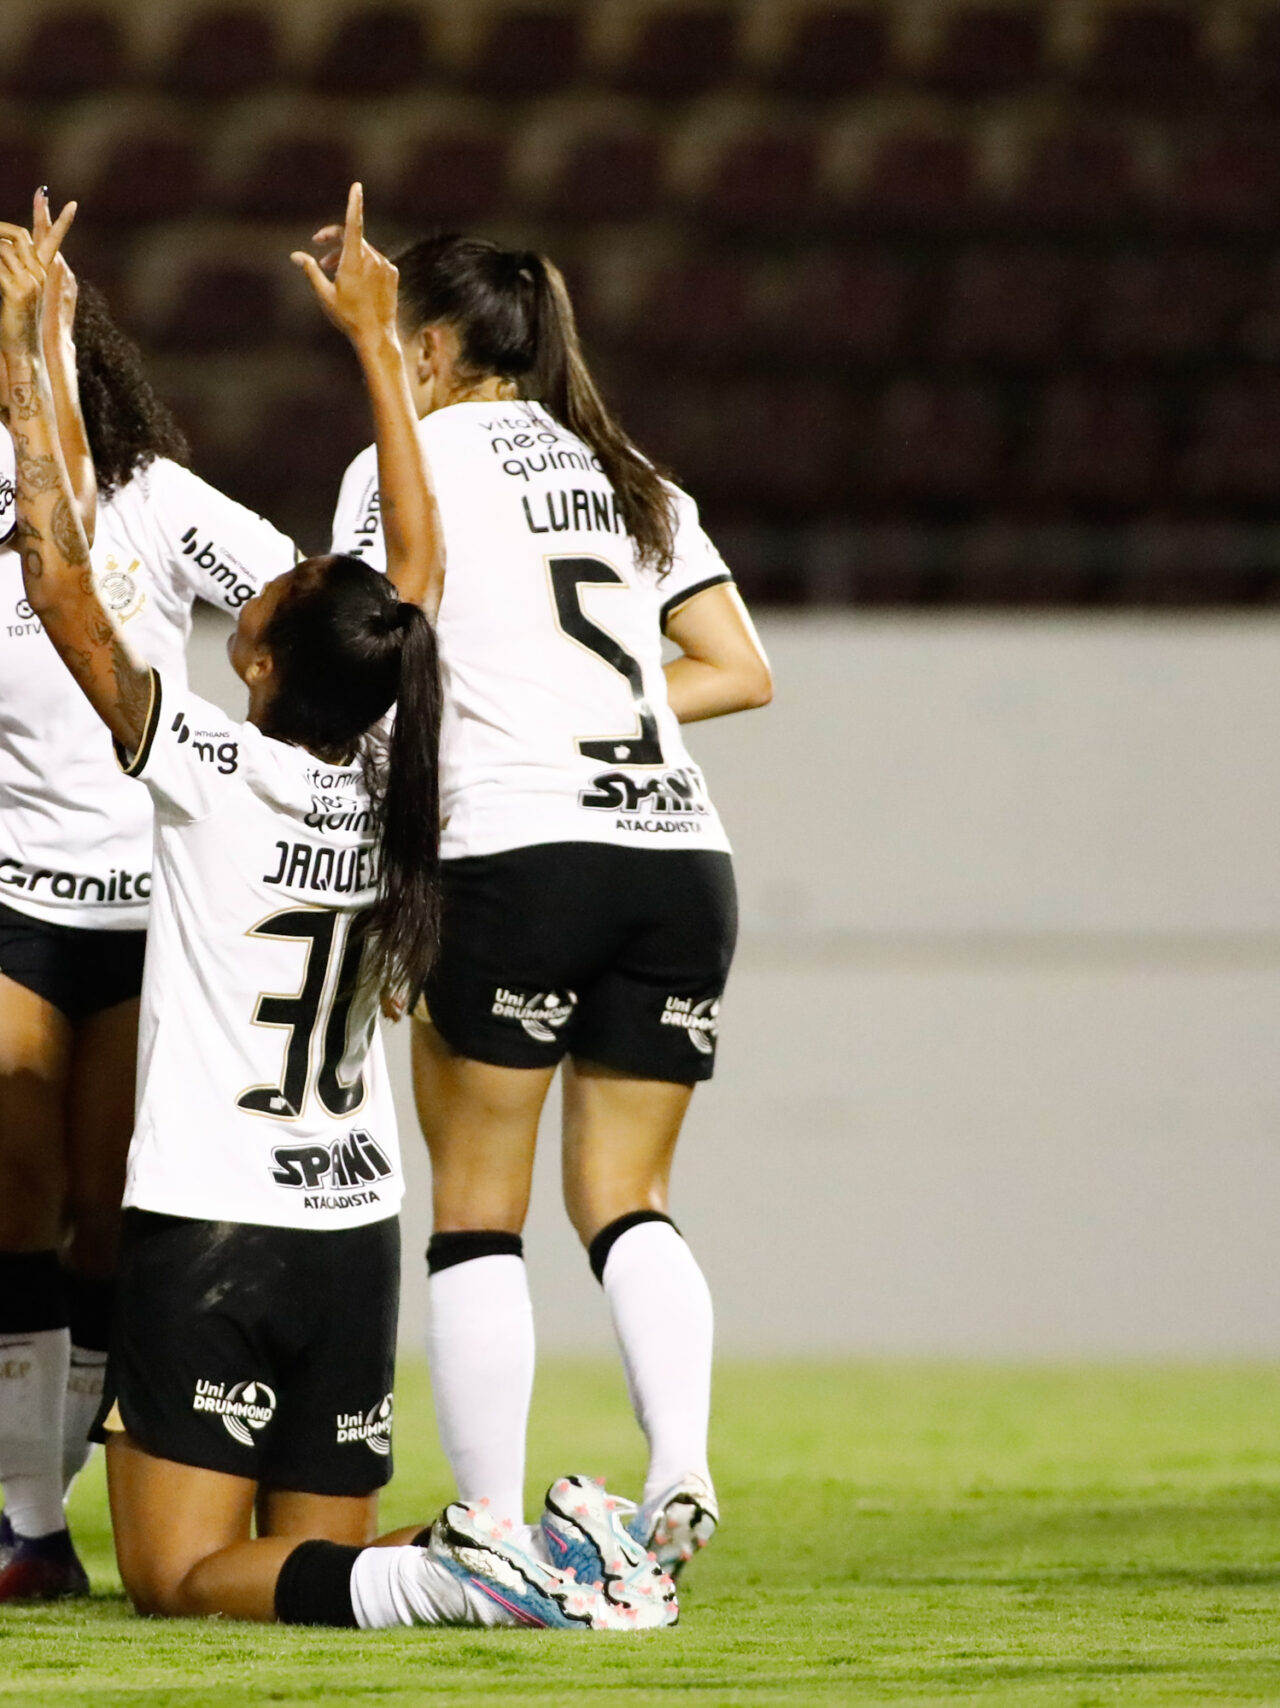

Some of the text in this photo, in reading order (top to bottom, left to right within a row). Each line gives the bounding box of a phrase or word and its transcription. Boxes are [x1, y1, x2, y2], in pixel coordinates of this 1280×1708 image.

[491, 432, 558, 453] neo
[502, 445, 606, 482] químic
[193, 541, 257, 608] bmg
[6, 622, 42, 637] TOTV
[542, 553, 669, 770] 5
[194, 730, 230, 738] INTHIANS
[192, 741, 239, 775] mg
[262, 840, 380, 894] JAQUEL
[495, 988, 525, 1007] Uni
[665, 996, 692, 1013] Uni
[236, 905, 379, 1123] 30
[491, 1002, 573, 1020] DRUMMON
[660, 1010, 720, 1030] DRUMM
[304, 1190, 381, 1209] ATACADISTA
[195, 1379, 225, 1398] Uni
[193, 1395, 273, 1423] DRUMMOND
[336, 1410, 363, 1429] Uni
[336, 1414, 393, 1443] DRUMM
